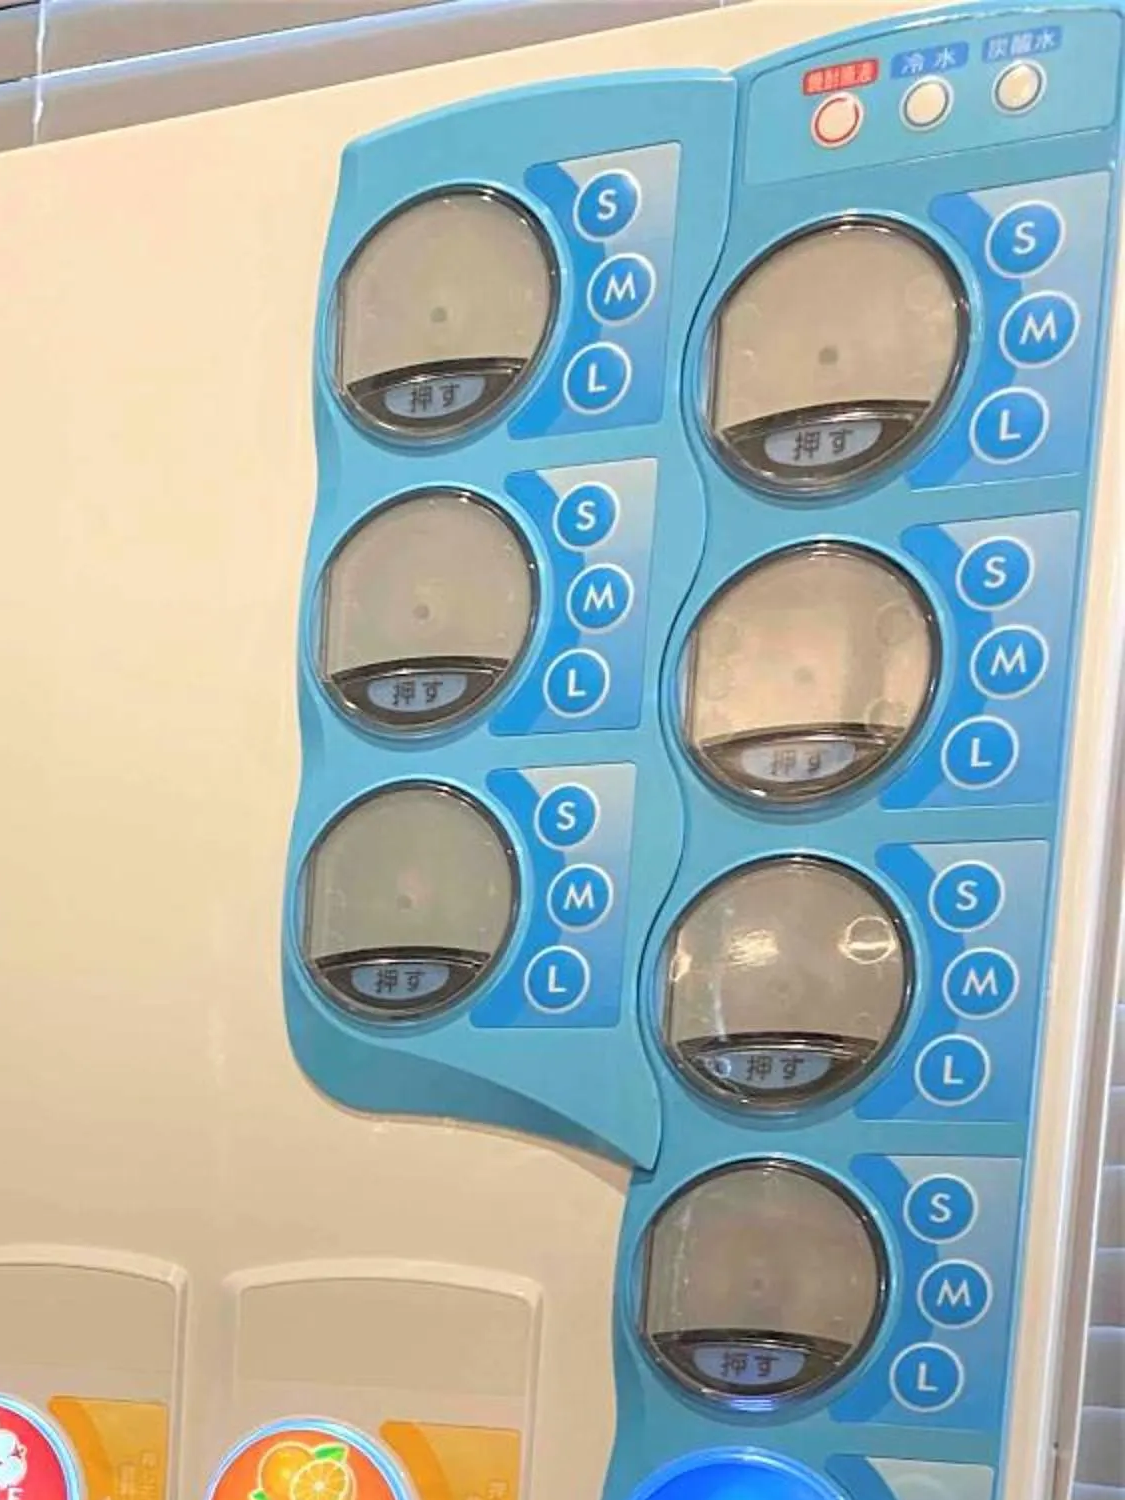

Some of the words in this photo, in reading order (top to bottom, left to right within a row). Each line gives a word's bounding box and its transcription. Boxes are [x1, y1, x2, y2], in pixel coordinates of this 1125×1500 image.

[597, 188, 618, 221] S
[1012, 220, 1037, 255] S
[603, 271, 636, 304] M
[1019, 309, 1058, 345] M
[587, 362, 608, 394] L
[409, 380, 462, 414] 押す
[998, 408, 1022, 442] L
[793, 427, 855, 462] 押す
[576, 500, 596, 531] S
[984, 555, 1008, 589] S
[583, 582, 615, 612] M
[990, 643, 1027, 676] M
[567, 668, 587, 698] L
[970, 737, 992, 768] L
[556, 800, 576, 831] S
[563, 881, 595, 910] M
[955, 879, 978, 912] S
[375, 968, 426, 994] 押す
[547, 964, 567, 993] L
[962, 967, 998, 996] M
[746, 1054, 805, 1082] 押す
[942, 1055, 964, 1085] L
[929, 1192, 952, 1224] S
[936, 1279, 972, 1307] M
[917, 1361, 938, 1392] L
